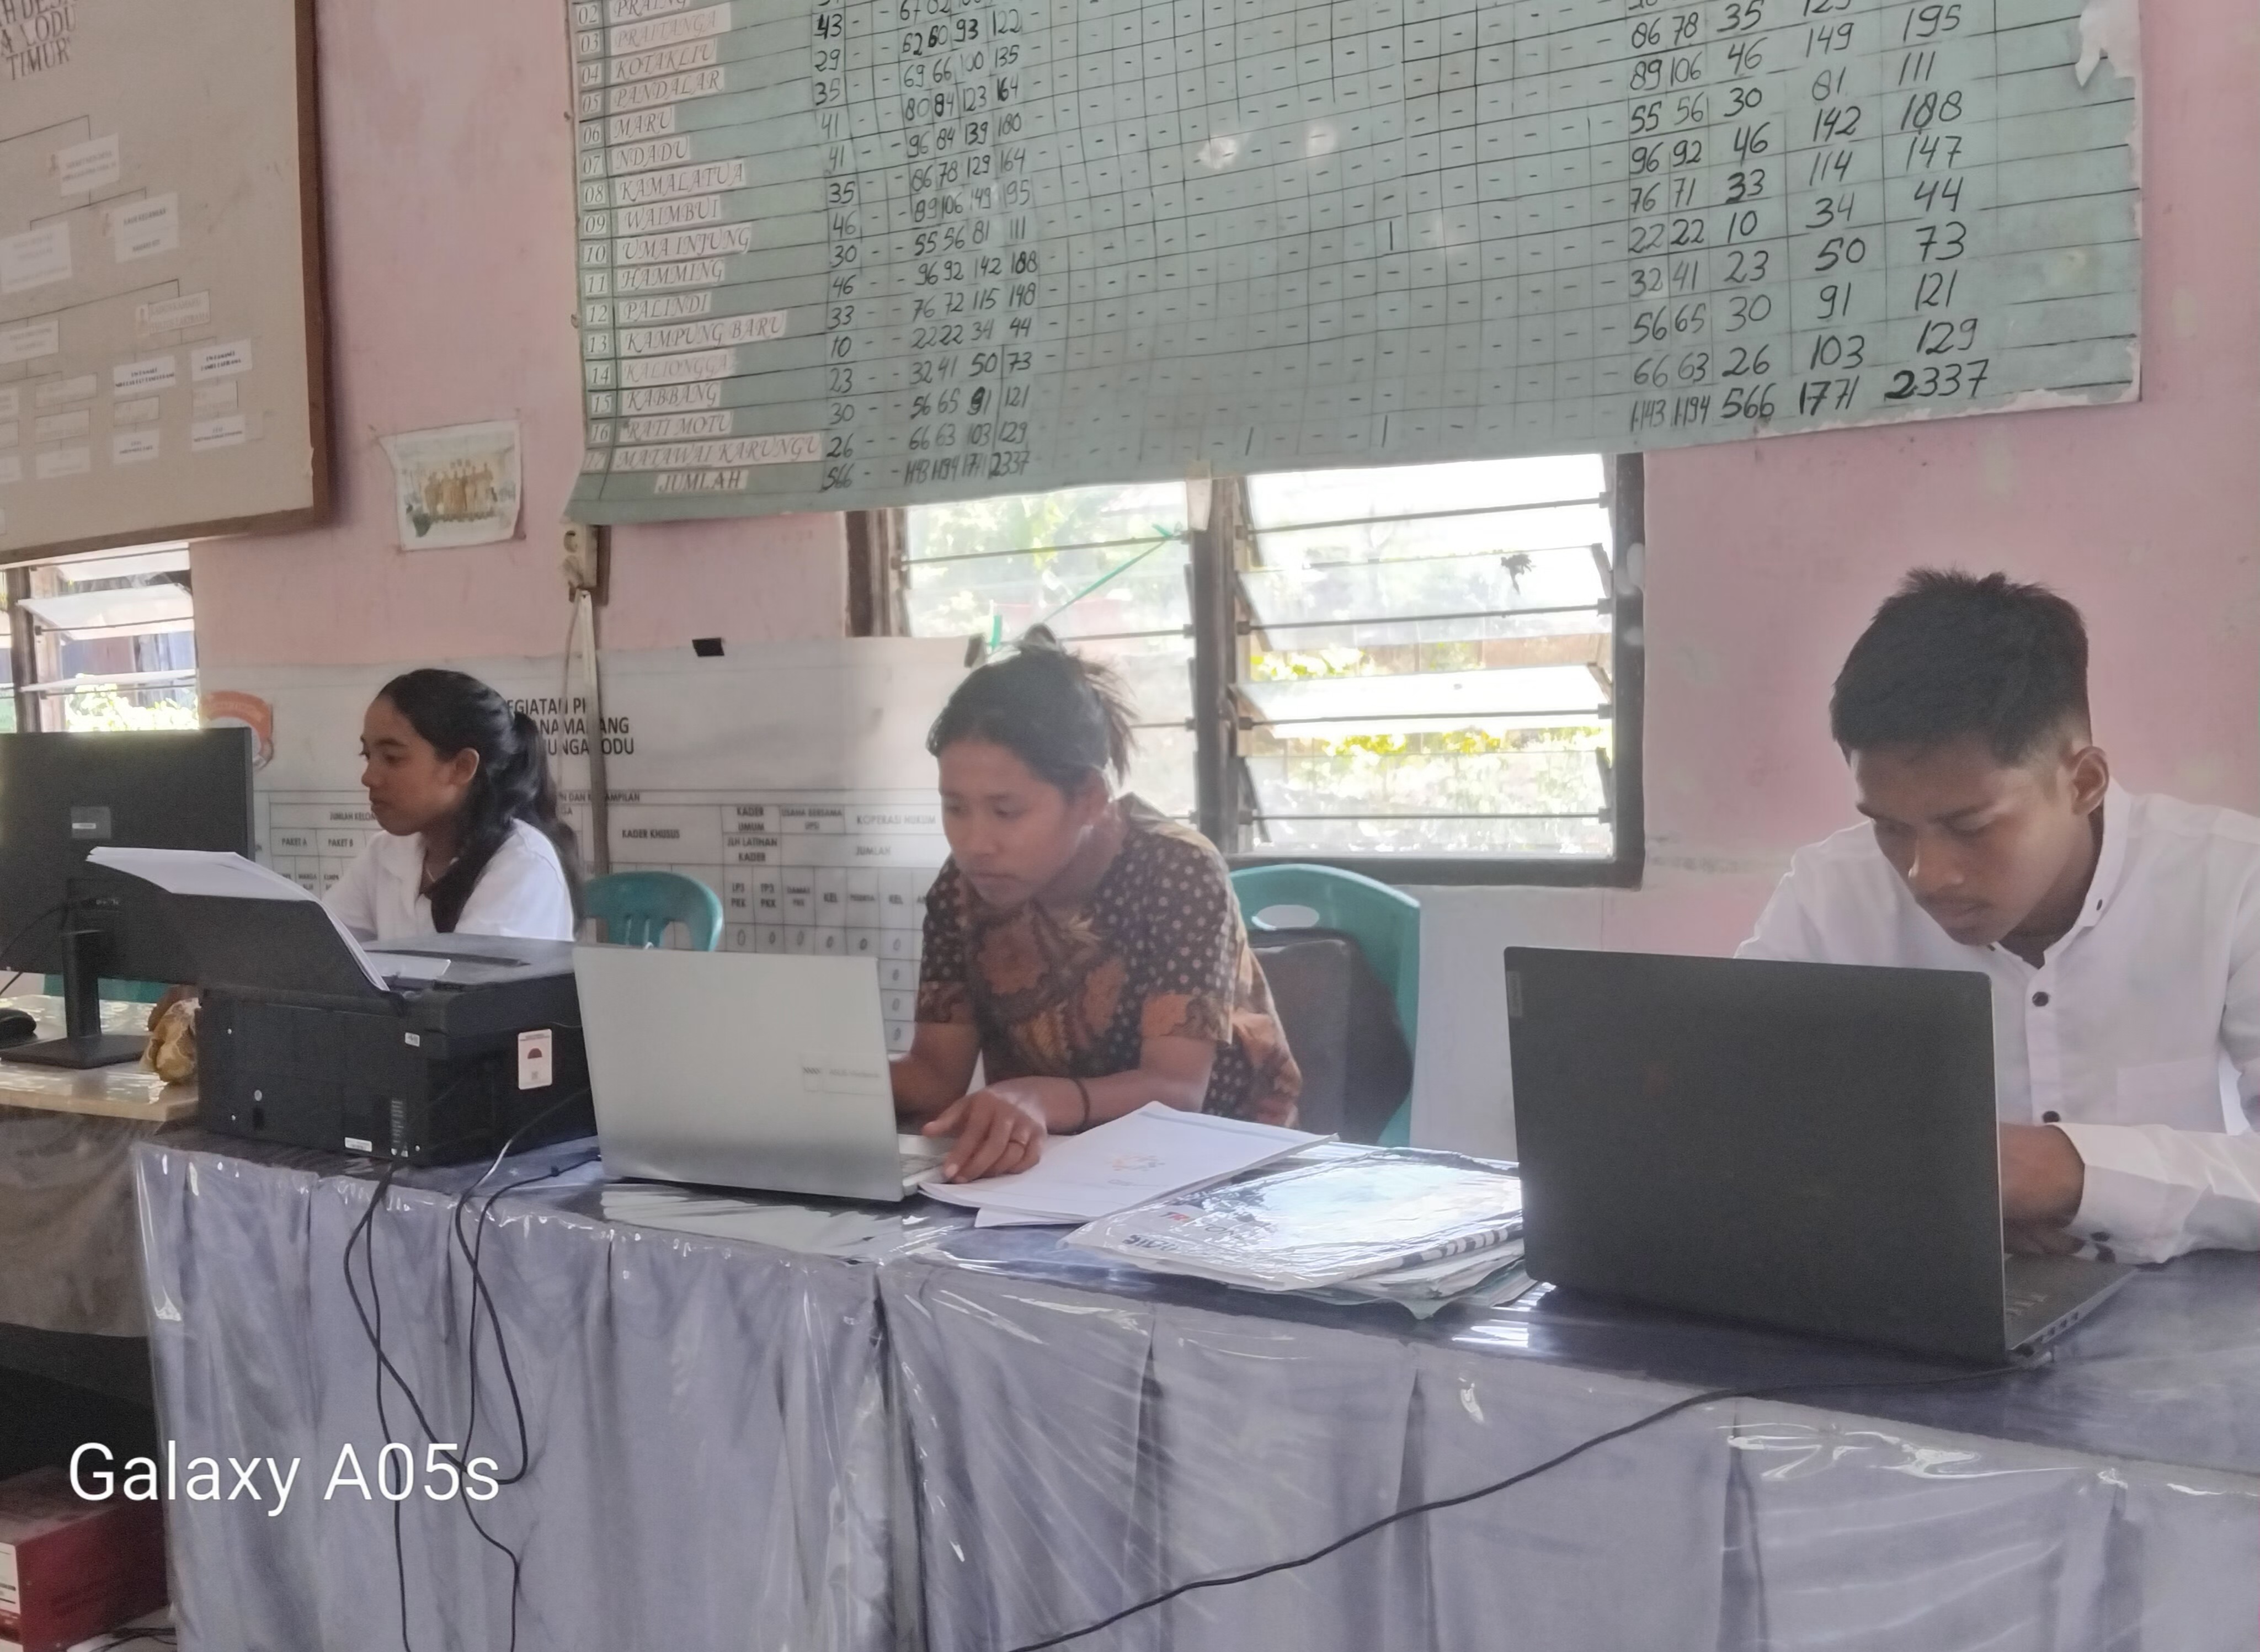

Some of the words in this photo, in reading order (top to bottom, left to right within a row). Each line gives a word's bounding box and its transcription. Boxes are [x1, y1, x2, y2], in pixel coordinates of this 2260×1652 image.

[579, 5, 597, 25] 02
[993, 9, 1021, 36] 122
[1632, 17, 1661, 49] 86
[1672, 12, 1699, 46] 78
[1717, 0, 1764, 33] 35
[6, 36, 70, 81] TIMUR
[582, 33, 598, 52] 03
[1630, 59, 1662, 90] 89
[1671, 51, 1703, 87] 106
[1727, 37, 1768, 75] 46
[1806, 22, 1854, 58] 149
[1902, 4, 1962, 43] 195
[583, 66, 598, 83] 04
[814, 49, 840, 72] 29
[904, 65, 925, 87] 69
[933, 57, 951, 83] 66
[995, 45, 1020, 68] 135
[583, 94, 600, 112] 05
[814, 78, 840, 106] 35
[905, 98, 929, 121] 80
[963, 86, 987, 111] 123
[1629, 100, 1662, 134] 55
[1673, 92, 1704, 126] 56
[1724, 87, 1762, 117] 30
[1811, 66, 1846, 101] 81
[1898, 51, 1936, 86] 111
[583, 128, 600, 143] 06
[615, 109, 673, 140] MARU
[822, 113, 839, 139] 41
[907, 131, 929, 158] 96
[937, 126, 955, 150] 84
[1629, 141, 1664, 174] 96
[1673, 140, 1702, 167] 92
[1734, 122, 1770, 167] 46
[1813, 106, 1861, 142] 142
[1901, 90, 1963, 131] 188
[583, 157, 600, 173] 07
[615, 138, 689, 169] NDADU
[829, 145, 844, 170] 41
[912, 165, 933, 191] 86
[939, 161, 958, 188] 78
[967, 155, 990, 178] 129
[1000, 147, 1026, 174] 164
[1630, 182, 1660, 213] 76
[1673, 177, 1696, 207] 71
[1725, 168, 1765, 204] 33
[1809, 150, 1853, 186] 114
[1906, 135, 1962, 172] 147
[585, 186, 604, 203] 08
[830, 182, 855, 204] 35
[914, 198, 937, 222] 89
[1003, 179, 1030, 208] 195
[585, 215, 605, 232] 09
[833, 210, 856, 235] 46
[914, 231, 937, 256] 55
[943, 226, 964, 251] 56
[973, 220, 989, 244] 81
[1628, 223, 1665, 253] 22
[1671, 219, 1704, 246] 22
[1727, 210, 1757, 243] 10
[1806, 192, 1854, 228] 34
[1913, 177, 1964, 212] 44
[587, 245, 606, 262] 10
[831, 244, 856, 268] 30
[914, 261, 938, 285] 96
[944, 260, 964, 280] 92
[974, 255, 1002, 279] 142
[1629, 268, 1662, 297] 32
[1672, 260, 1698, 291] 41
[1724, 251, 1768, 283] 23
[1815, 237, 1865, 271] 50
[1916, 221, 1966, 262] 73
[589, 276, 606, 292] 11
[832, 275, 854, 298] 46
[944, 292, 964, 315] 72
[590, 306, 607, 322] 12
[1628, 306, 1667, 344] 56
[1675, 303, 1706, 333] 65
[1725, 294, 1771, 332] 30
[1817, 282, 1851, 319] 91
[1915, 269, 1958, 312] 121
[590, 335, 607, 353] 13
[627, 324, 723, 353] KAMPUNG
[732, 315, 785, 338] BARU
[828, 306, 854, 330] 33
[912, 327, 937, 349] 22
[940, 324, 964, 345] 22
[1010, 317, 1032, 338] 44
[831, 336, 851, 359] 10
[938, 356, 958, 380] 41
[969, 353, 998, 377] 50
[1007, 351, 1032, 374] 73
[1634, 354, 1671, 387] 66
[1678, 351, 1709, 383] 63
[1721, 344, 1769, 377] 26
[1810, 334, 1864, 370] 103
[1917, 318, 1978, 355] 129
[593, 367, 609, 383] 14
[830, 367, 852, 392] 23
[938, 388, 961, 414] 65
[1005, 385, 1030, 408] 121
[593, 396, 611, 413] 15
[626, 383, 717, 411] KABBANG
[830, 404, 854, 424] 30
[1720, 383, 1776, 418] 566
[593, 425, 608, 440] 16
[827, 434, 853, 458] 26
[658, 471, 740, 491] JUMLAH
